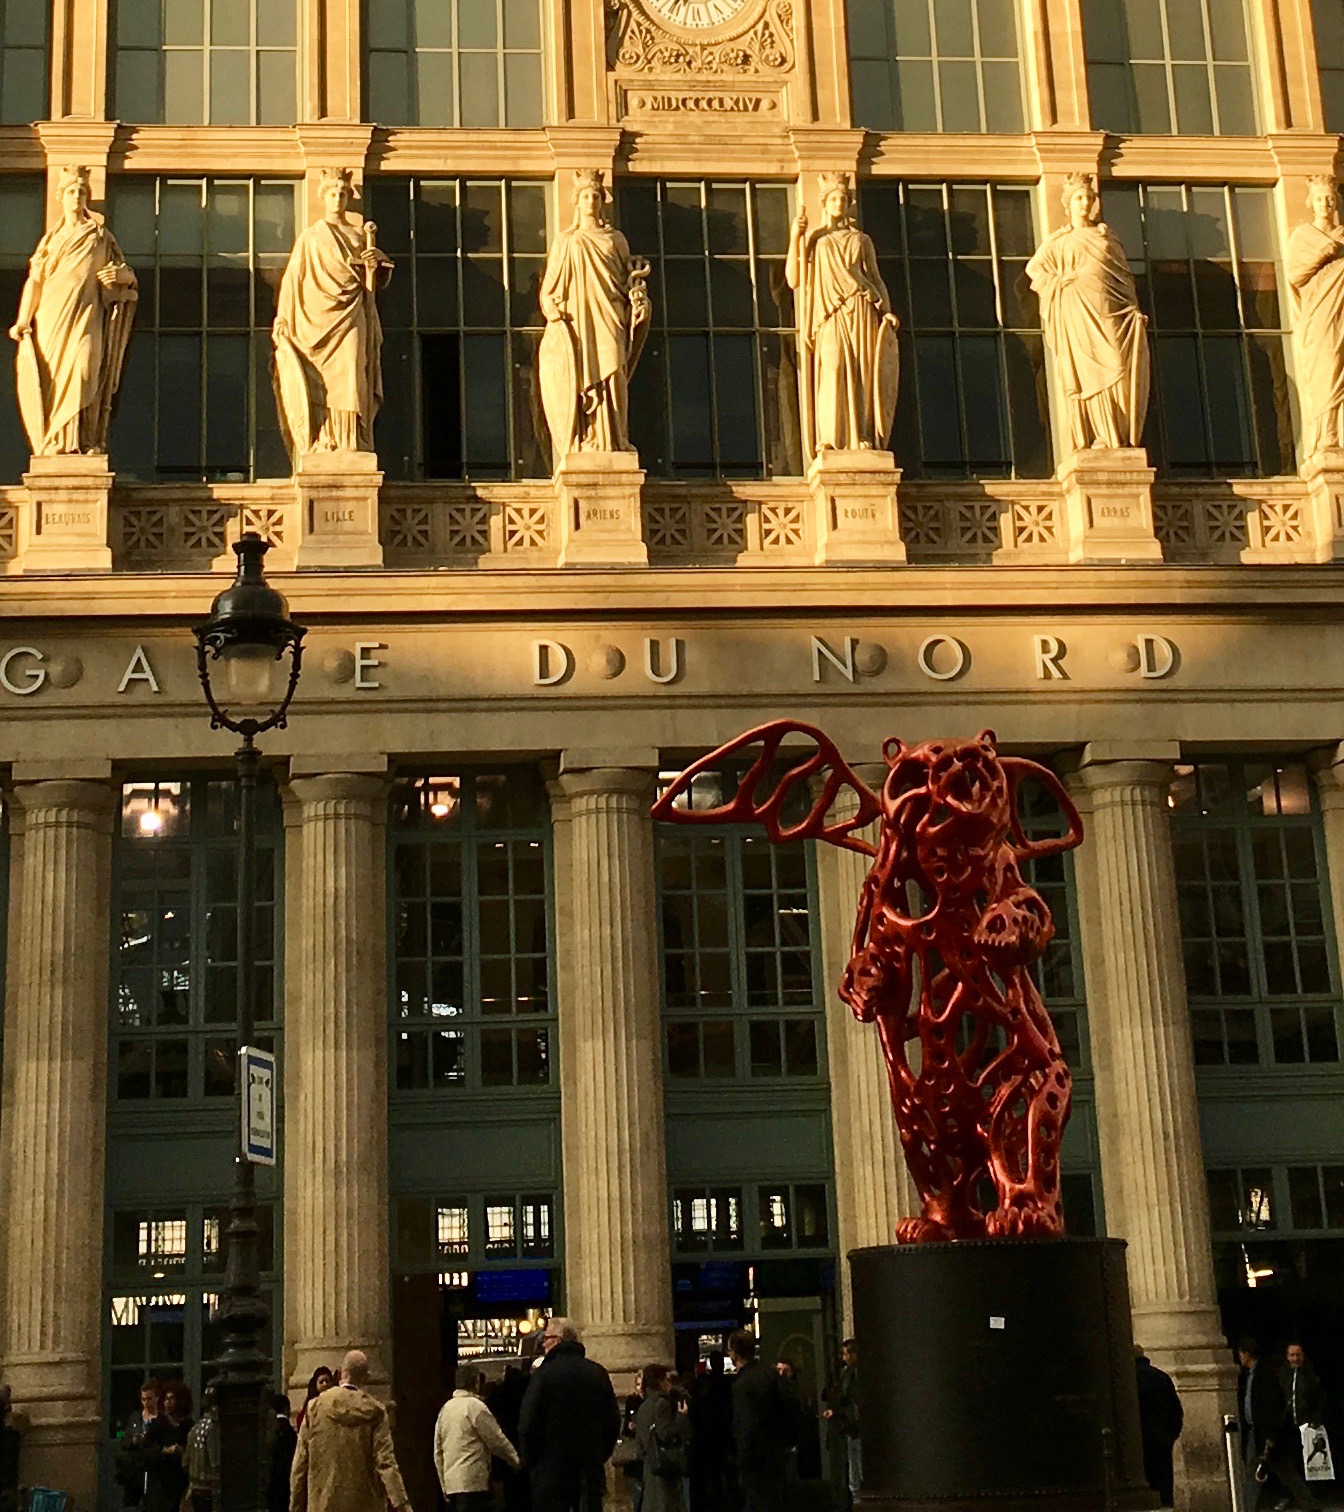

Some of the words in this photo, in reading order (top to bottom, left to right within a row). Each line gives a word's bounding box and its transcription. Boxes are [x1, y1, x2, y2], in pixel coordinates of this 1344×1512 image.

[649, 95, 762, 112] MDCCCLXIV
[324, 510, 355, 522] LILLE
[0, 641, 382, 695] GAE
[532, 637, 679, 686] DU
[810, 633, 1174, 683] NORD
